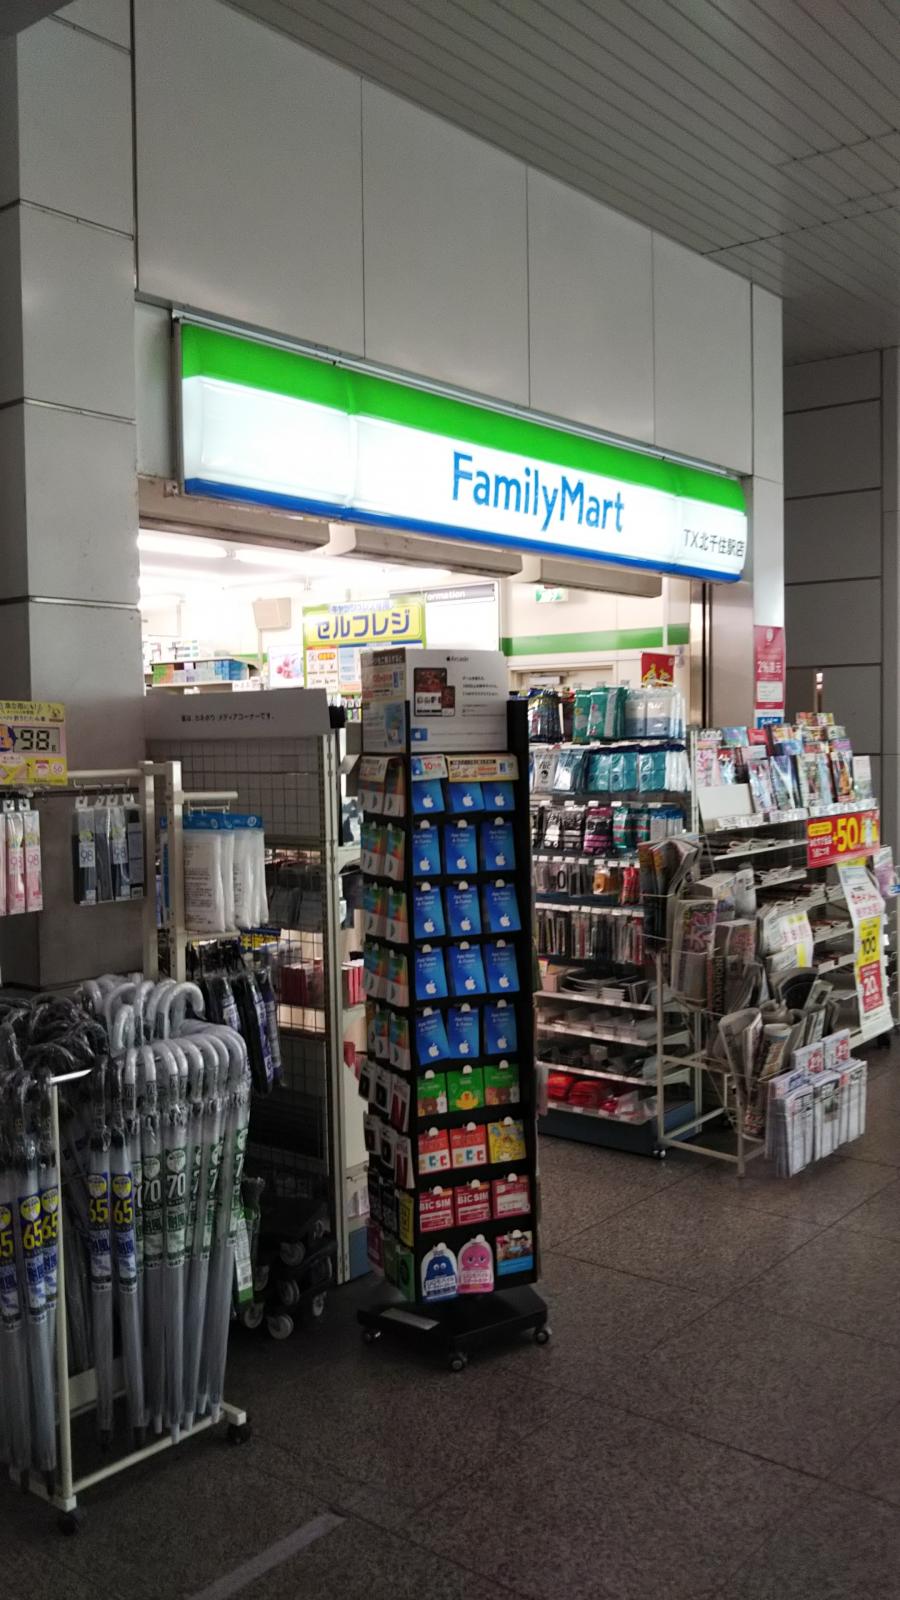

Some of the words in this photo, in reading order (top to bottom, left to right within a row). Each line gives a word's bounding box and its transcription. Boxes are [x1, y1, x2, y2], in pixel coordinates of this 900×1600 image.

[453, 451, 624, 532] FamilyMart
[683, 528, 745, 558] TX北千住駅店
[316, 609, 410, 640] セルフレジ
[81, 849, 94, 863] 98
[167, 1172, 186, 1200] 70
[88, 1198, 109, 1225] 65
[113, 1198, 133, 1225] 65
[0, 1230, 14, 1258] 5
[23, 1218, 43, 1251] 65
